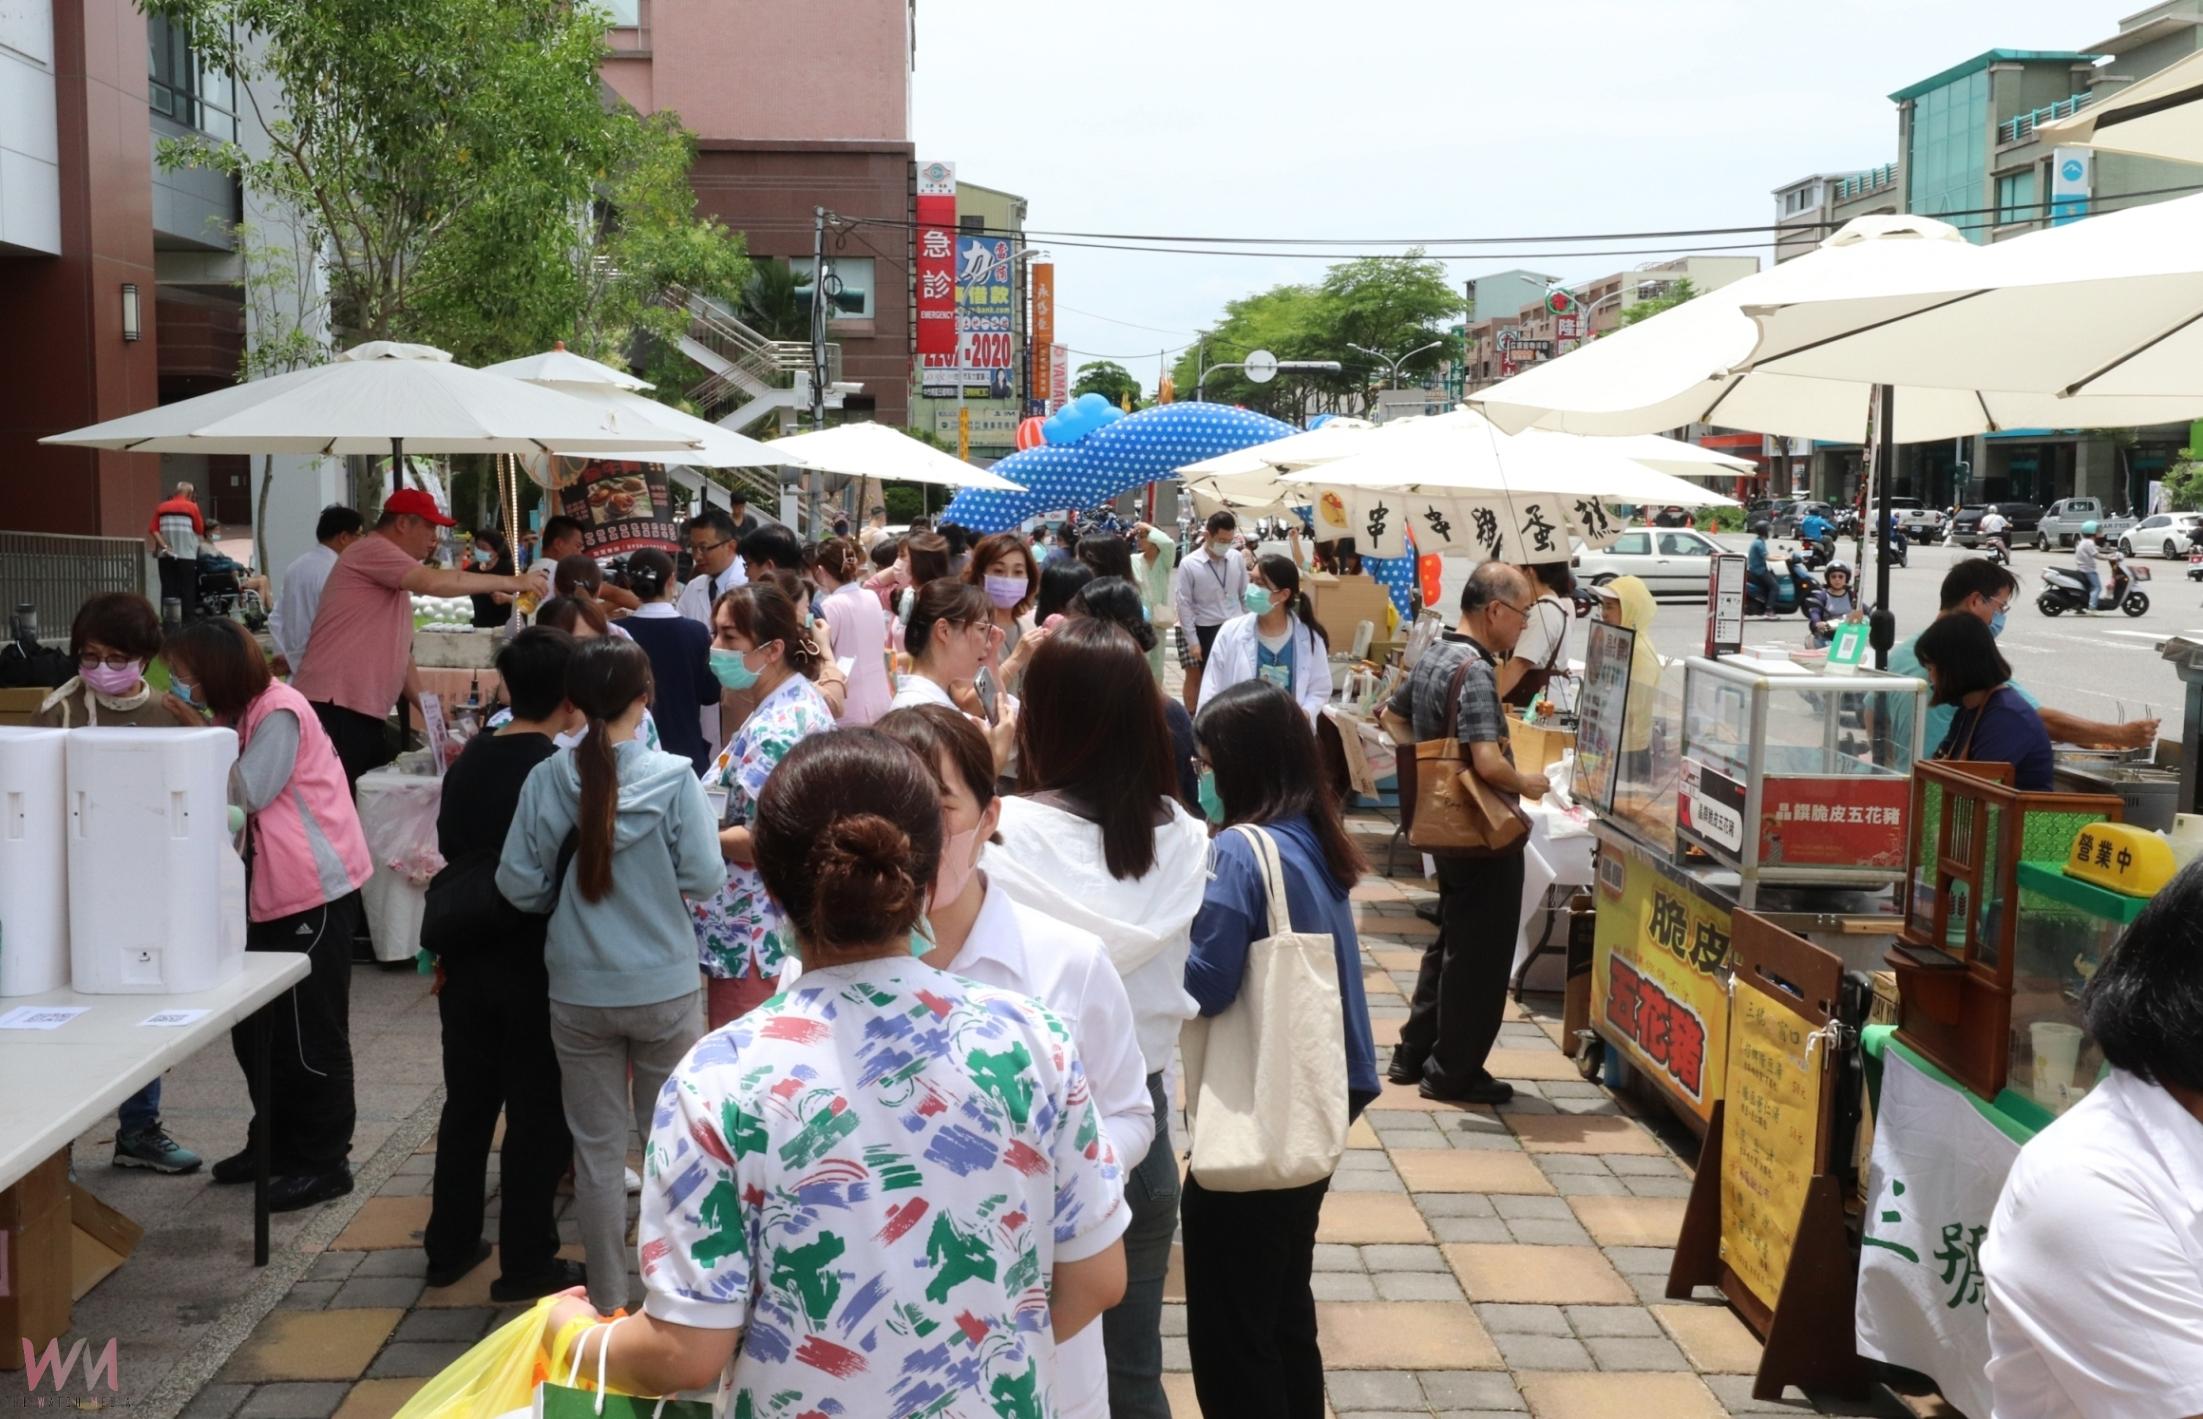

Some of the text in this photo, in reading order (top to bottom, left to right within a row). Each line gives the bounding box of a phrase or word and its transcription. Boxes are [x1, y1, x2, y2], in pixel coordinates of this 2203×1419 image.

[923, 230, 953, 299] 急診
[955, 286, 1009, 304] 借款
[2077, 832, 2132, 875] 營業中
[1648, 890, 1731, 976] 脆皮
[1605, 952, 1707, 1100] 五花豬
